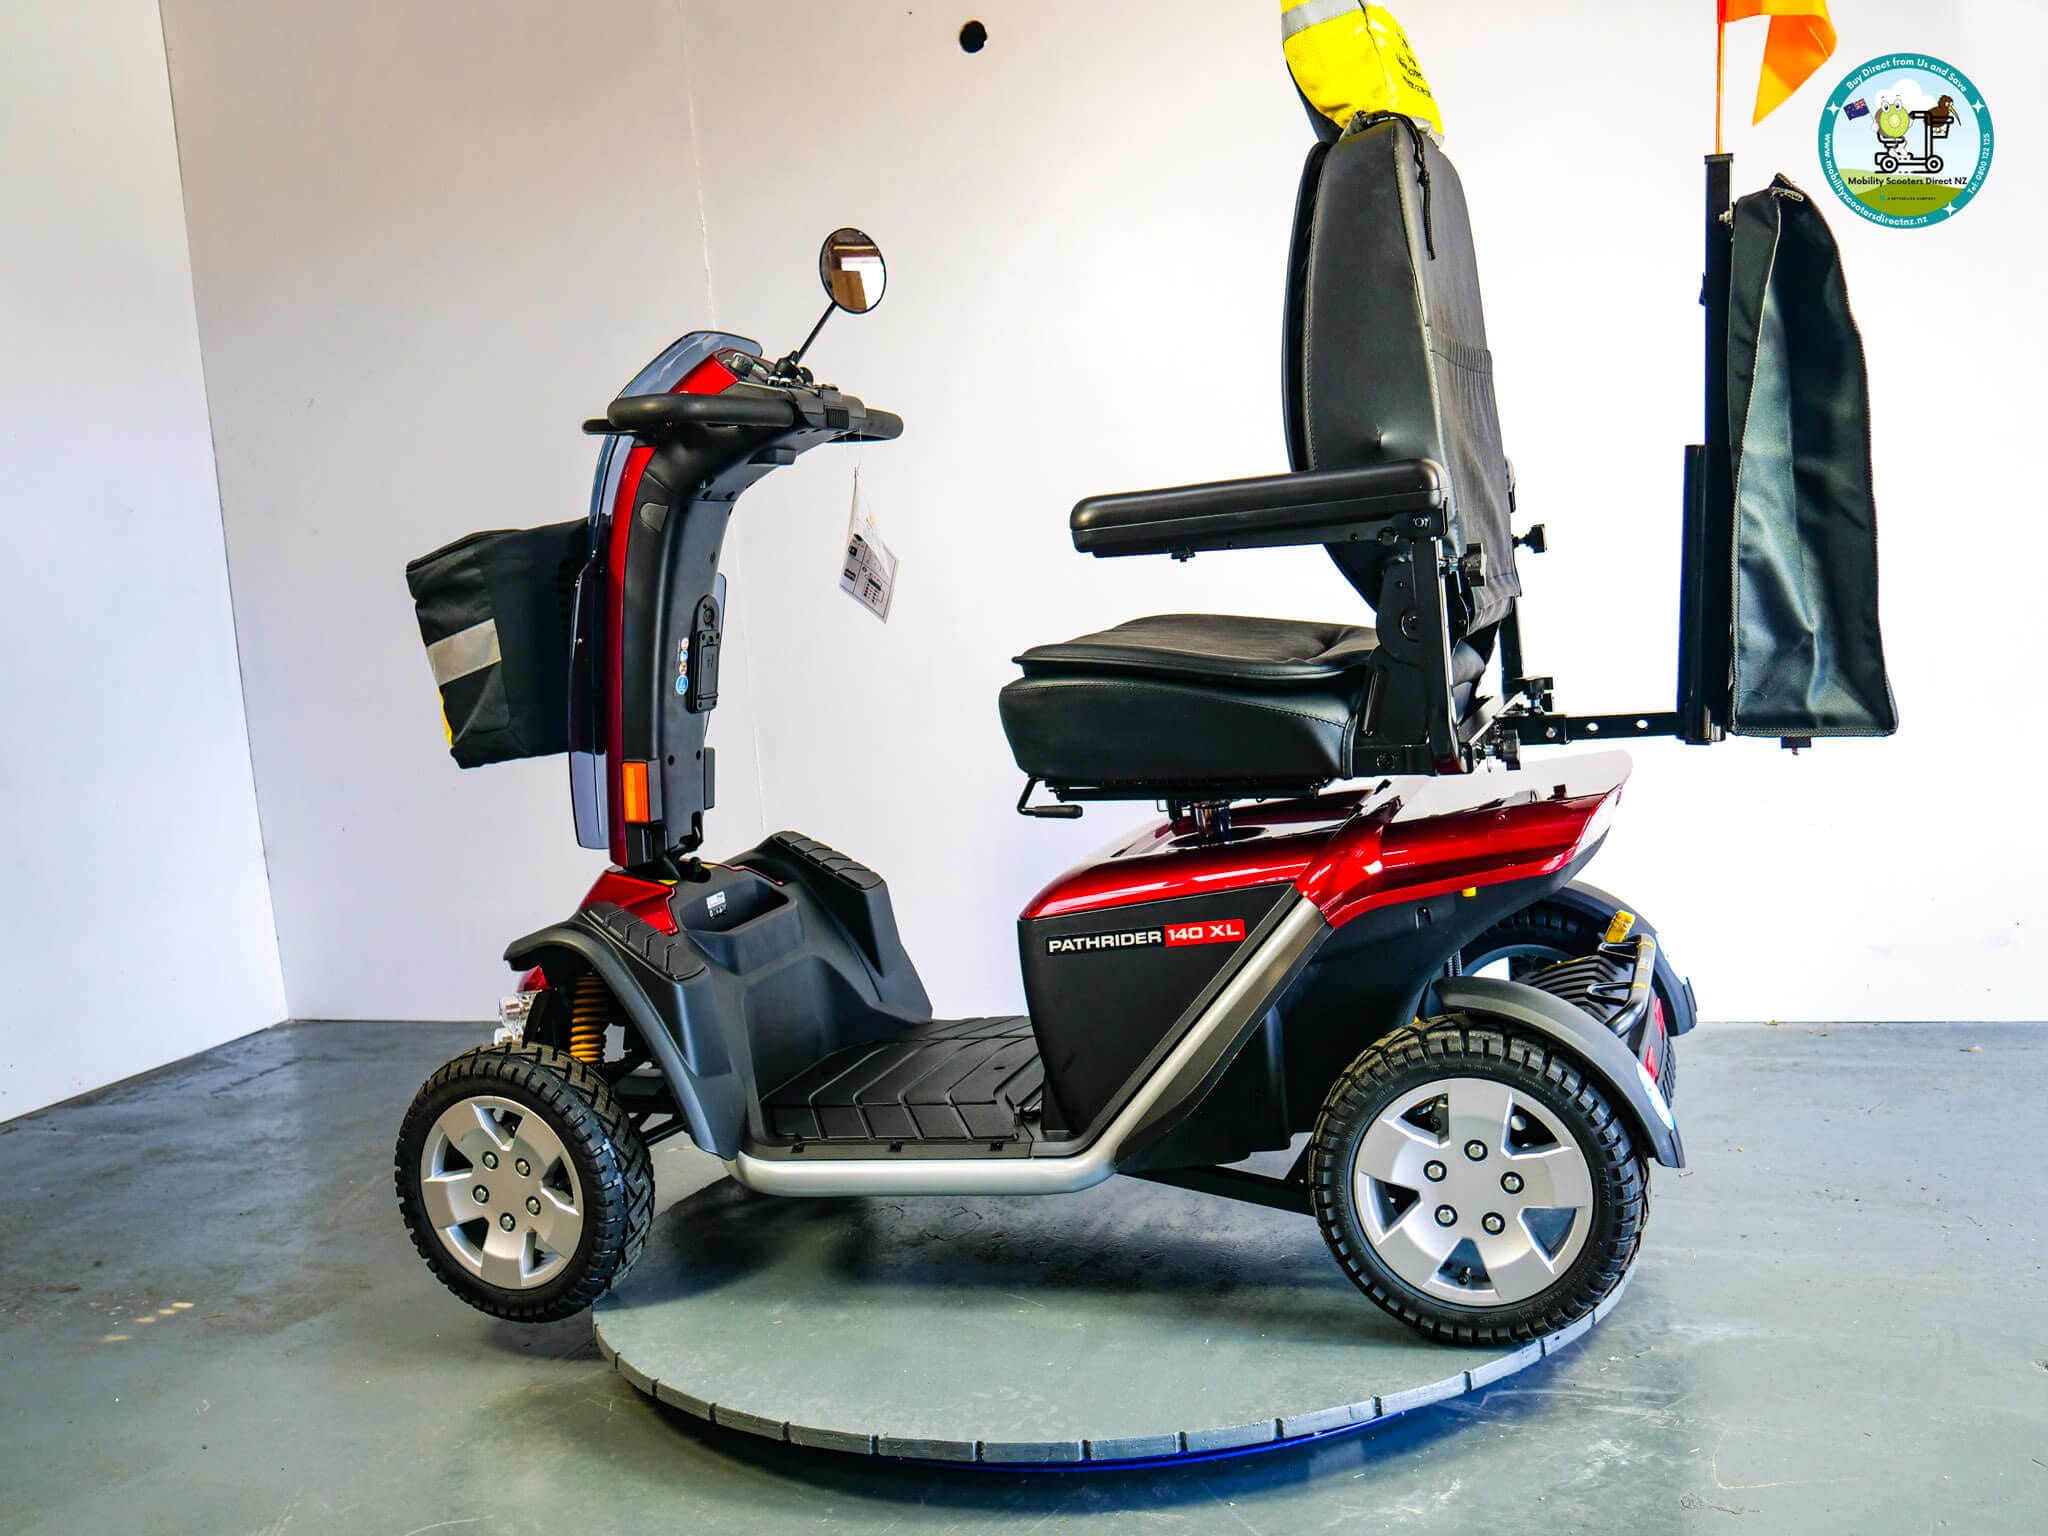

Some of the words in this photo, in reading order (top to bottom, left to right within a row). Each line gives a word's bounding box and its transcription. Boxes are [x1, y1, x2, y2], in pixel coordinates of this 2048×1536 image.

[1048, 930, 1162, 953] PATHRIDER
[1167, 926, 1203, 941] 140
[1209, 924, 1240, 938] XL
